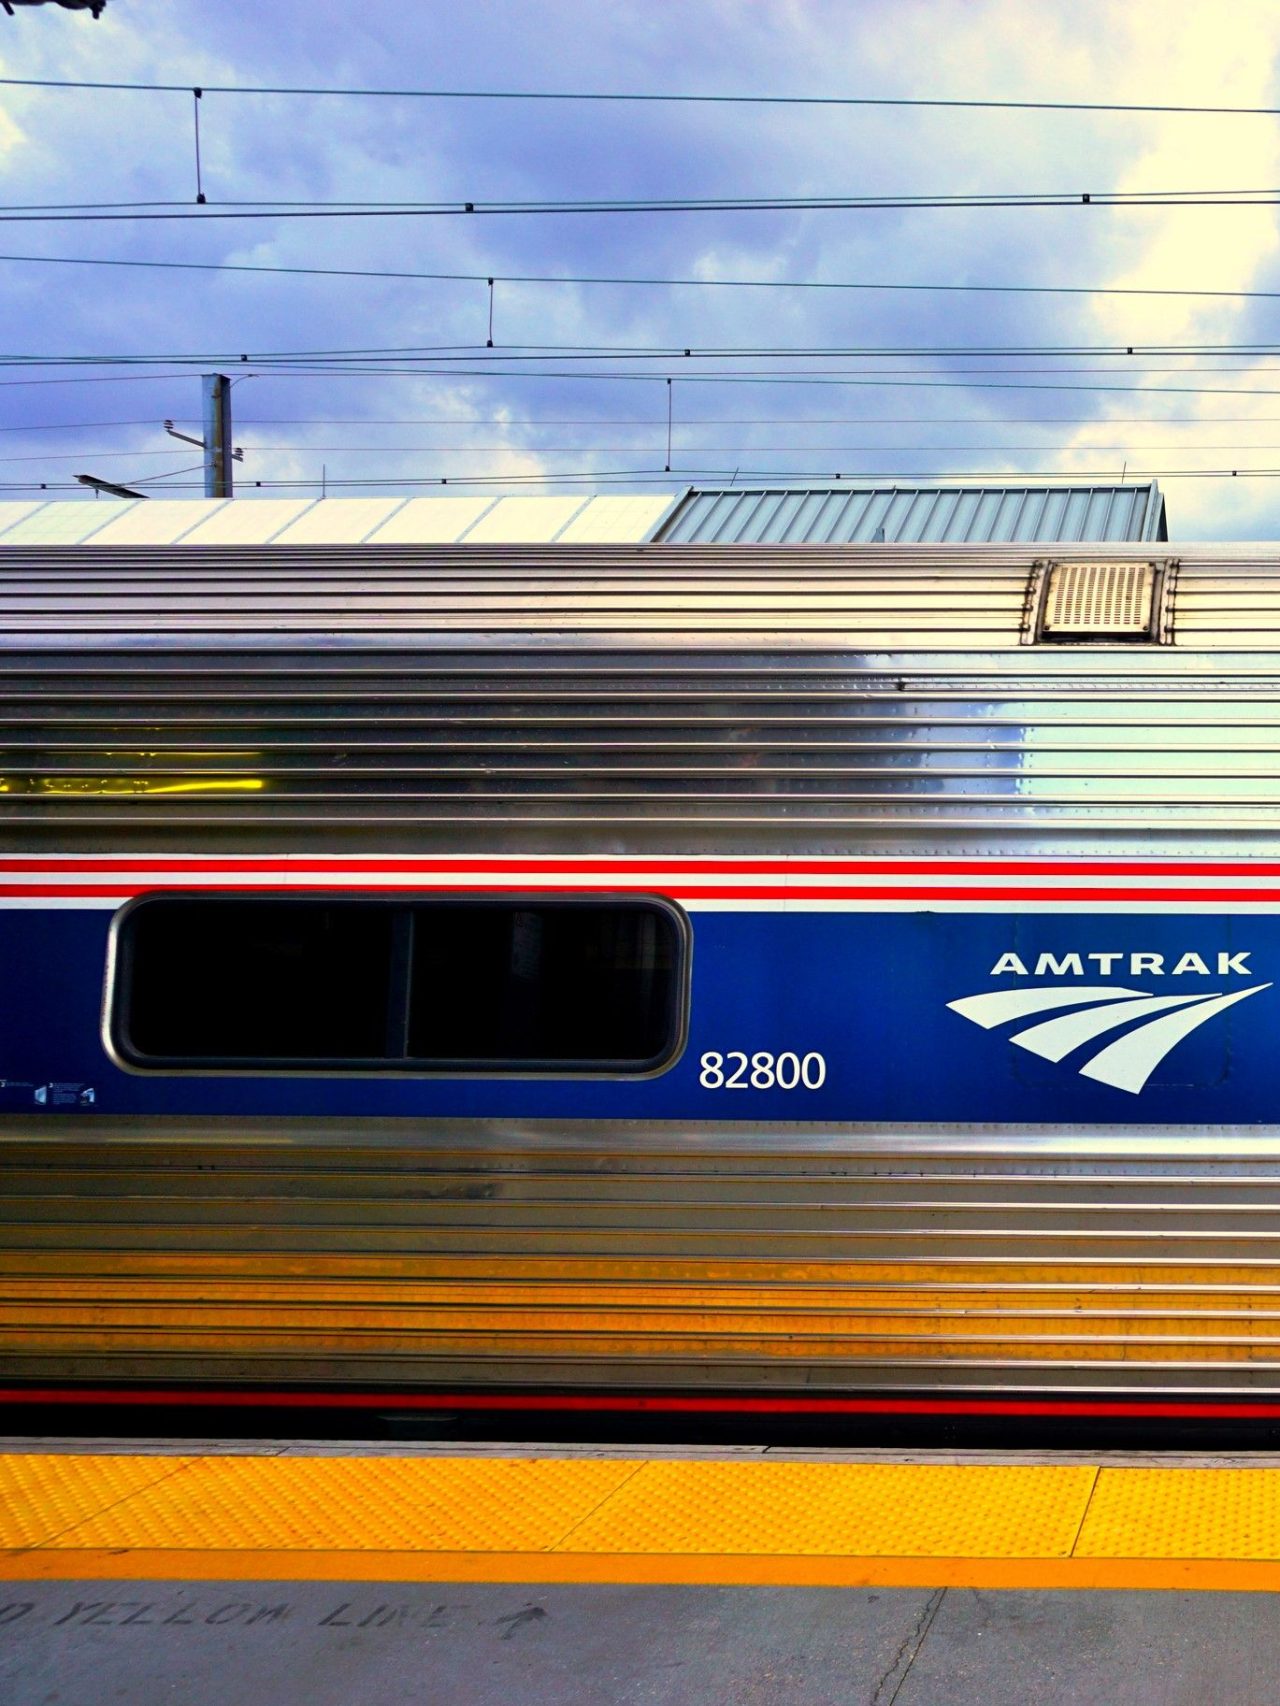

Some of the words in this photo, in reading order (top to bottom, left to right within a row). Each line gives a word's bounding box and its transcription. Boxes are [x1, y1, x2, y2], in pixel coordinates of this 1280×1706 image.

[989, 952, 1252, 976] AMTRAK
[699, 1051, 826, 1090] 82800
[53, 1601, 294, 1625] YELLOW
